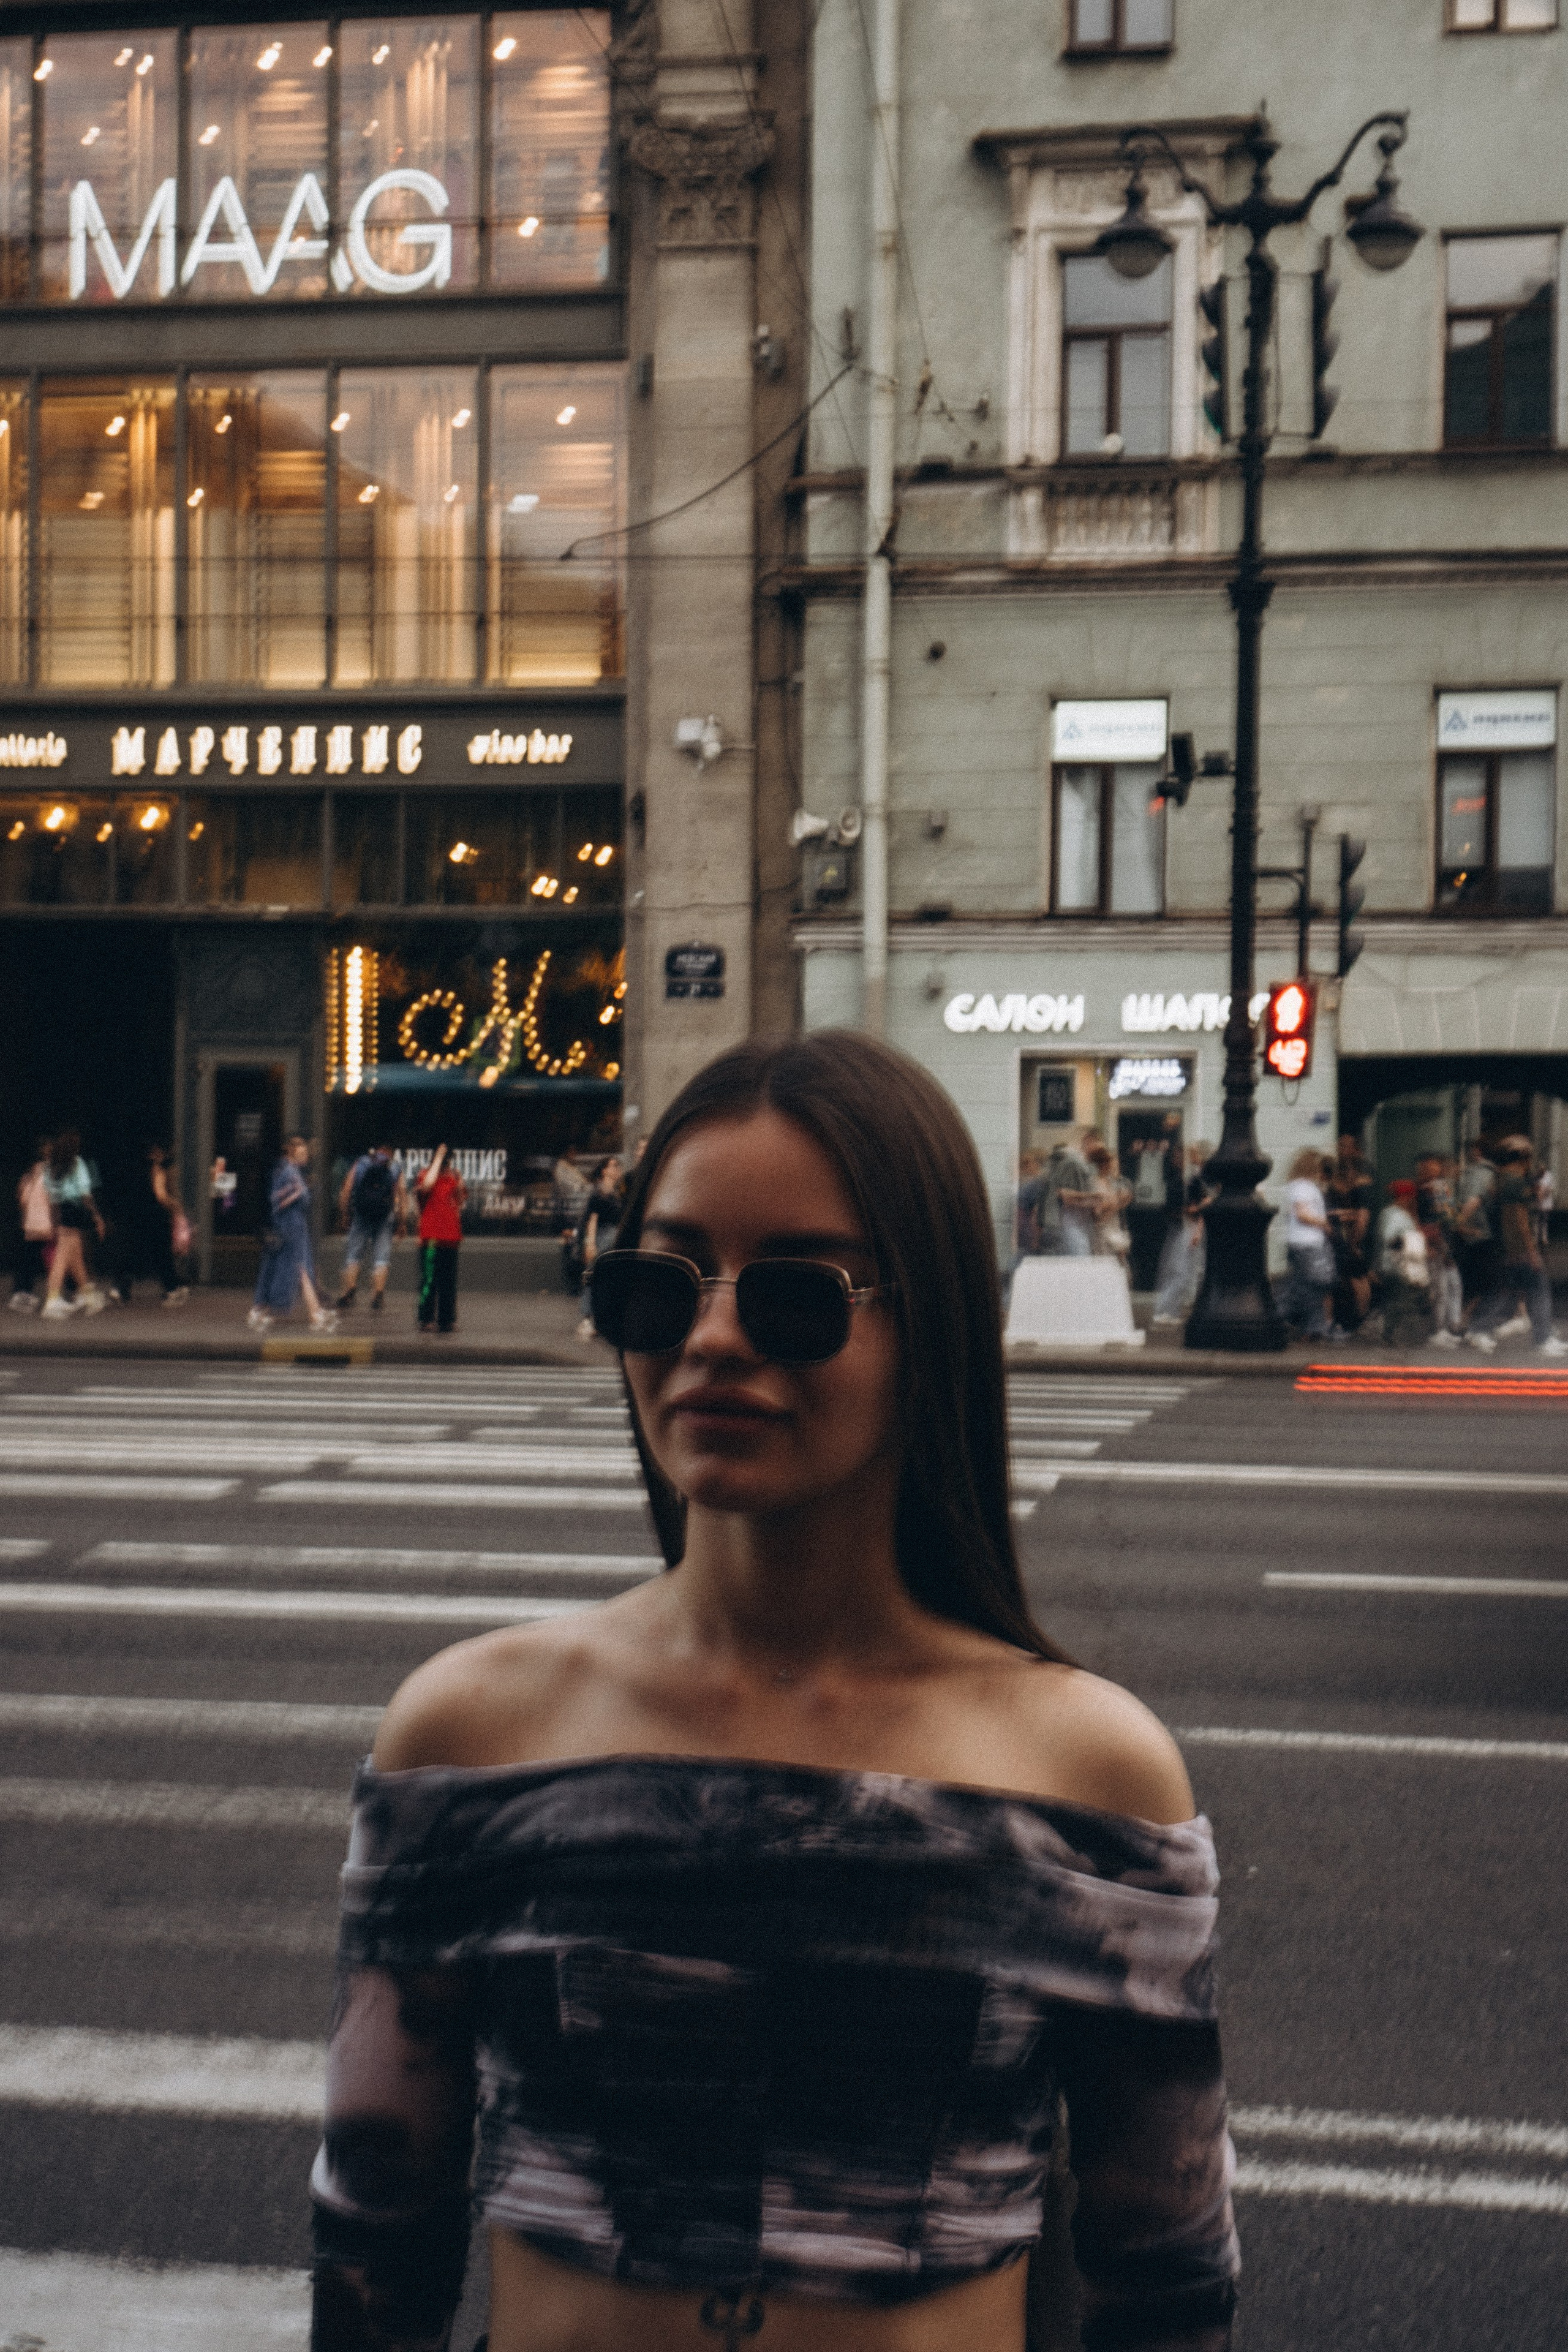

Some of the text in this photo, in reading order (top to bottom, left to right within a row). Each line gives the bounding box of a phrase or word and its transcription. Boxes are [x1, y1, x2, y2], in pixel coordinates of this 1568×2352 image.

[69, 168, 451, 300] MAAG
[943, 992, 1270, 1033] САЛОН ШАП
